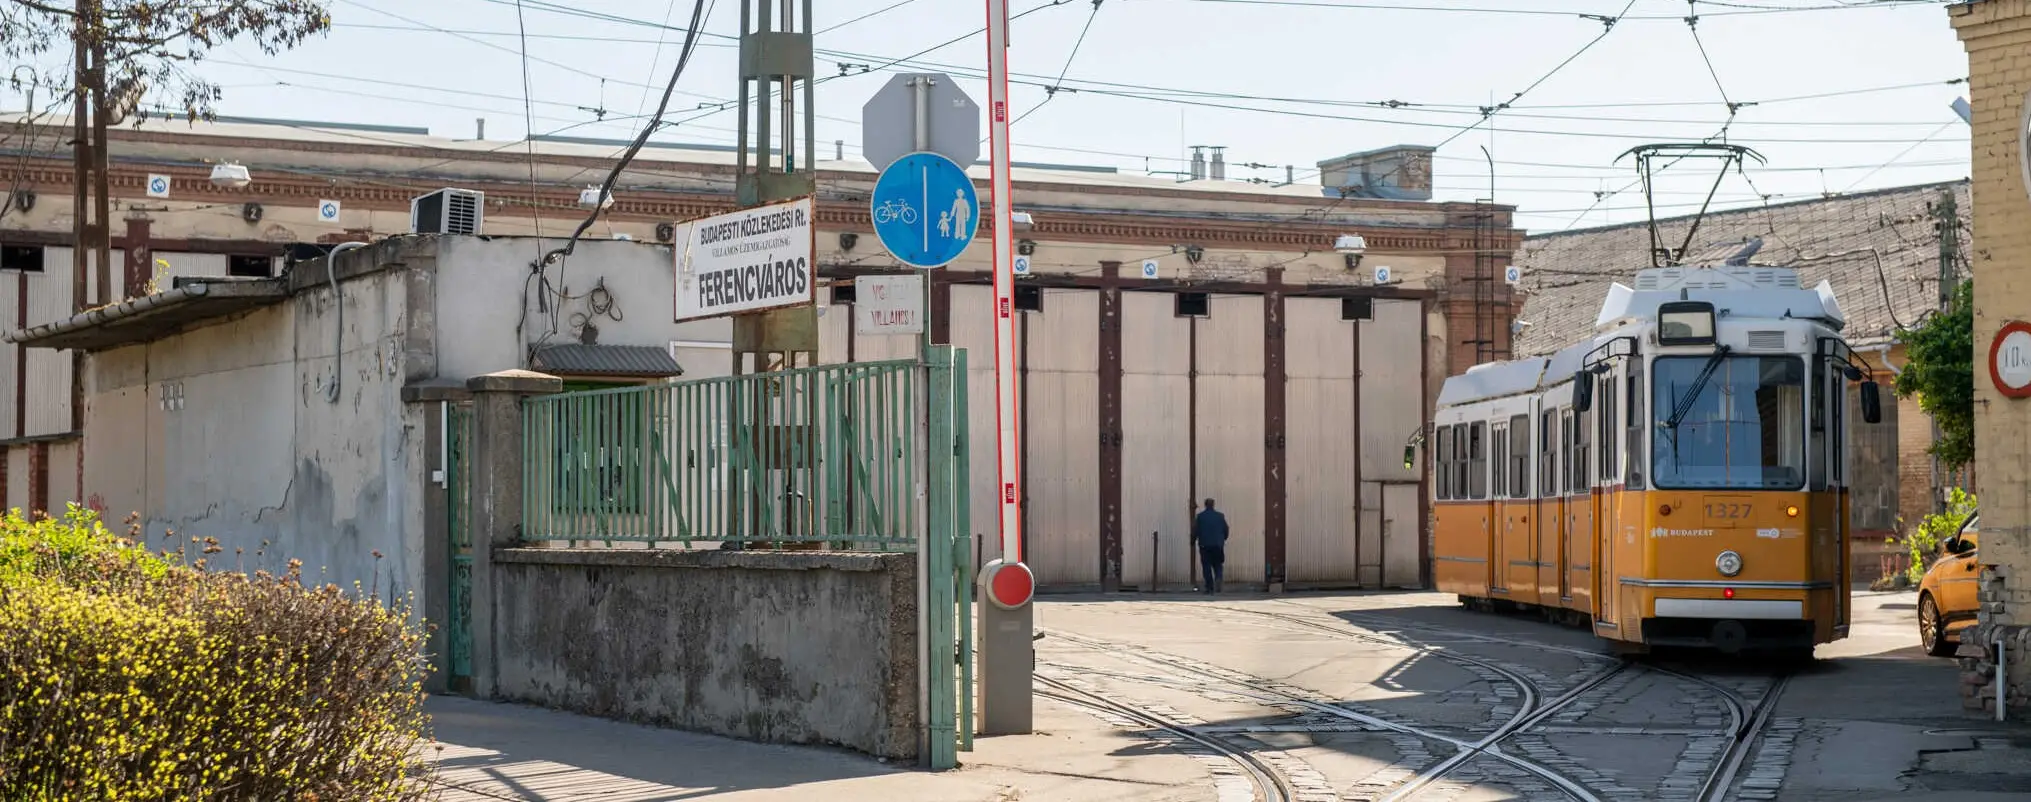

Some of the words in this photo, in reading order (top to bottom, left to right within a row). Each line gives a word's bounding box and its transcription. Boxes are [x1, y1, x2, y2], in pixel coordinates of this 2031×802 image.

[701, 221, 740, 245] BUDAPESTI
[741, 207, 794, 237] KÖZLEKEDÉSI
[795, 208, 807, 227] Rt.
[712, 246, 739, 258] VILLAMOS
[699, 253, 807, 308] FERENCVÁROS
[2005, 346, 2019, 368] 10
[1704, 504, 1753, 519] 1327
[1670, 529, 1714, 537] BUDAPEST
